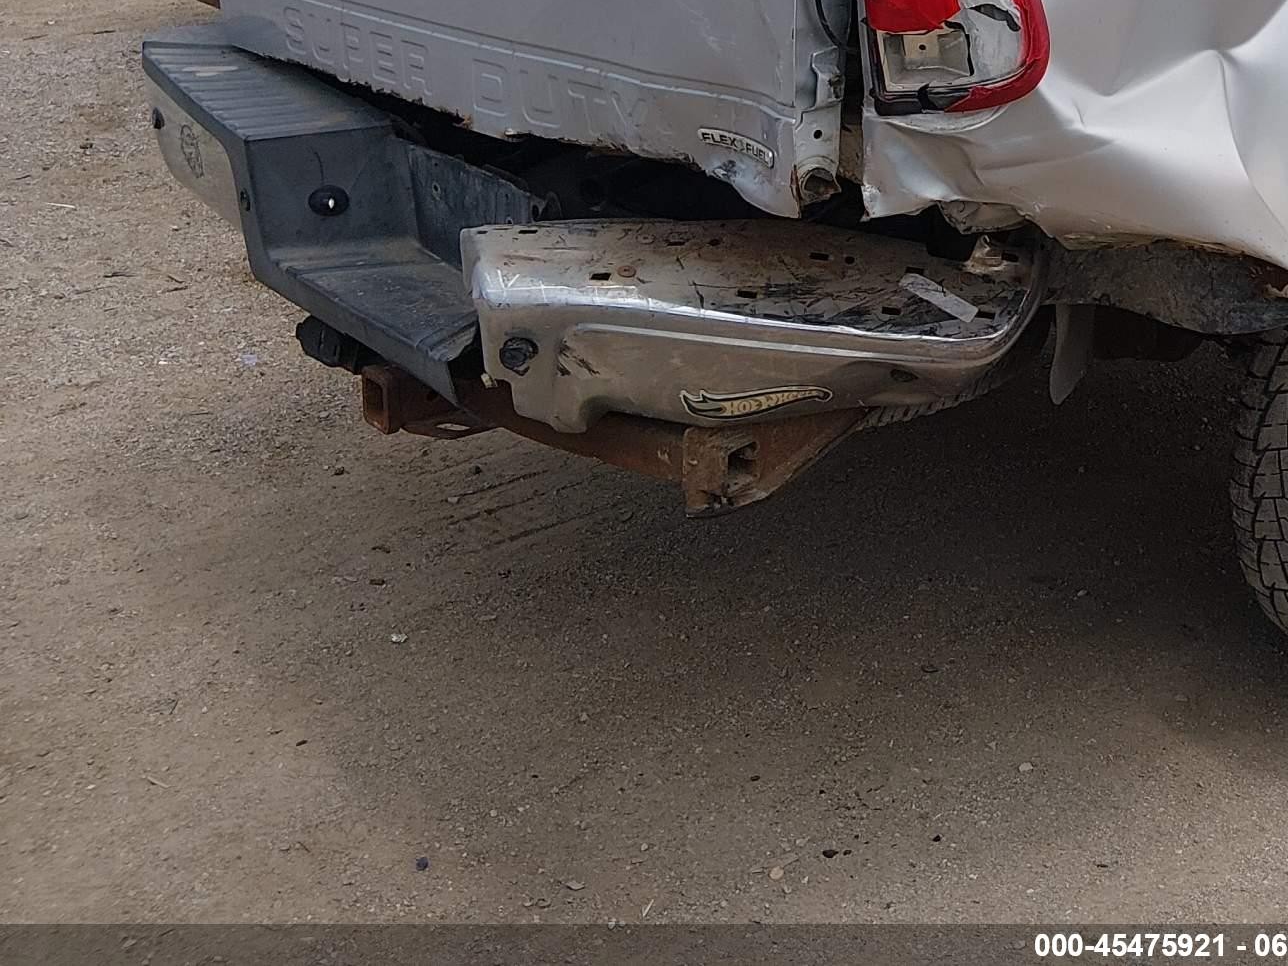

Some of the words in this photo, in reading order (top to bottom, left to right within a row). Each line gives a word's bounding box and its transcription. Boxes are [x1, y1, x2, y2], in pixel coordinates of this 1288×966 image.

[283, 6, 432, 97] SUPER
[472, 58, 645, 146] DUTY
[701, 132, 738, 148] FLEX
[745, 142, 770, 164] FUEL
